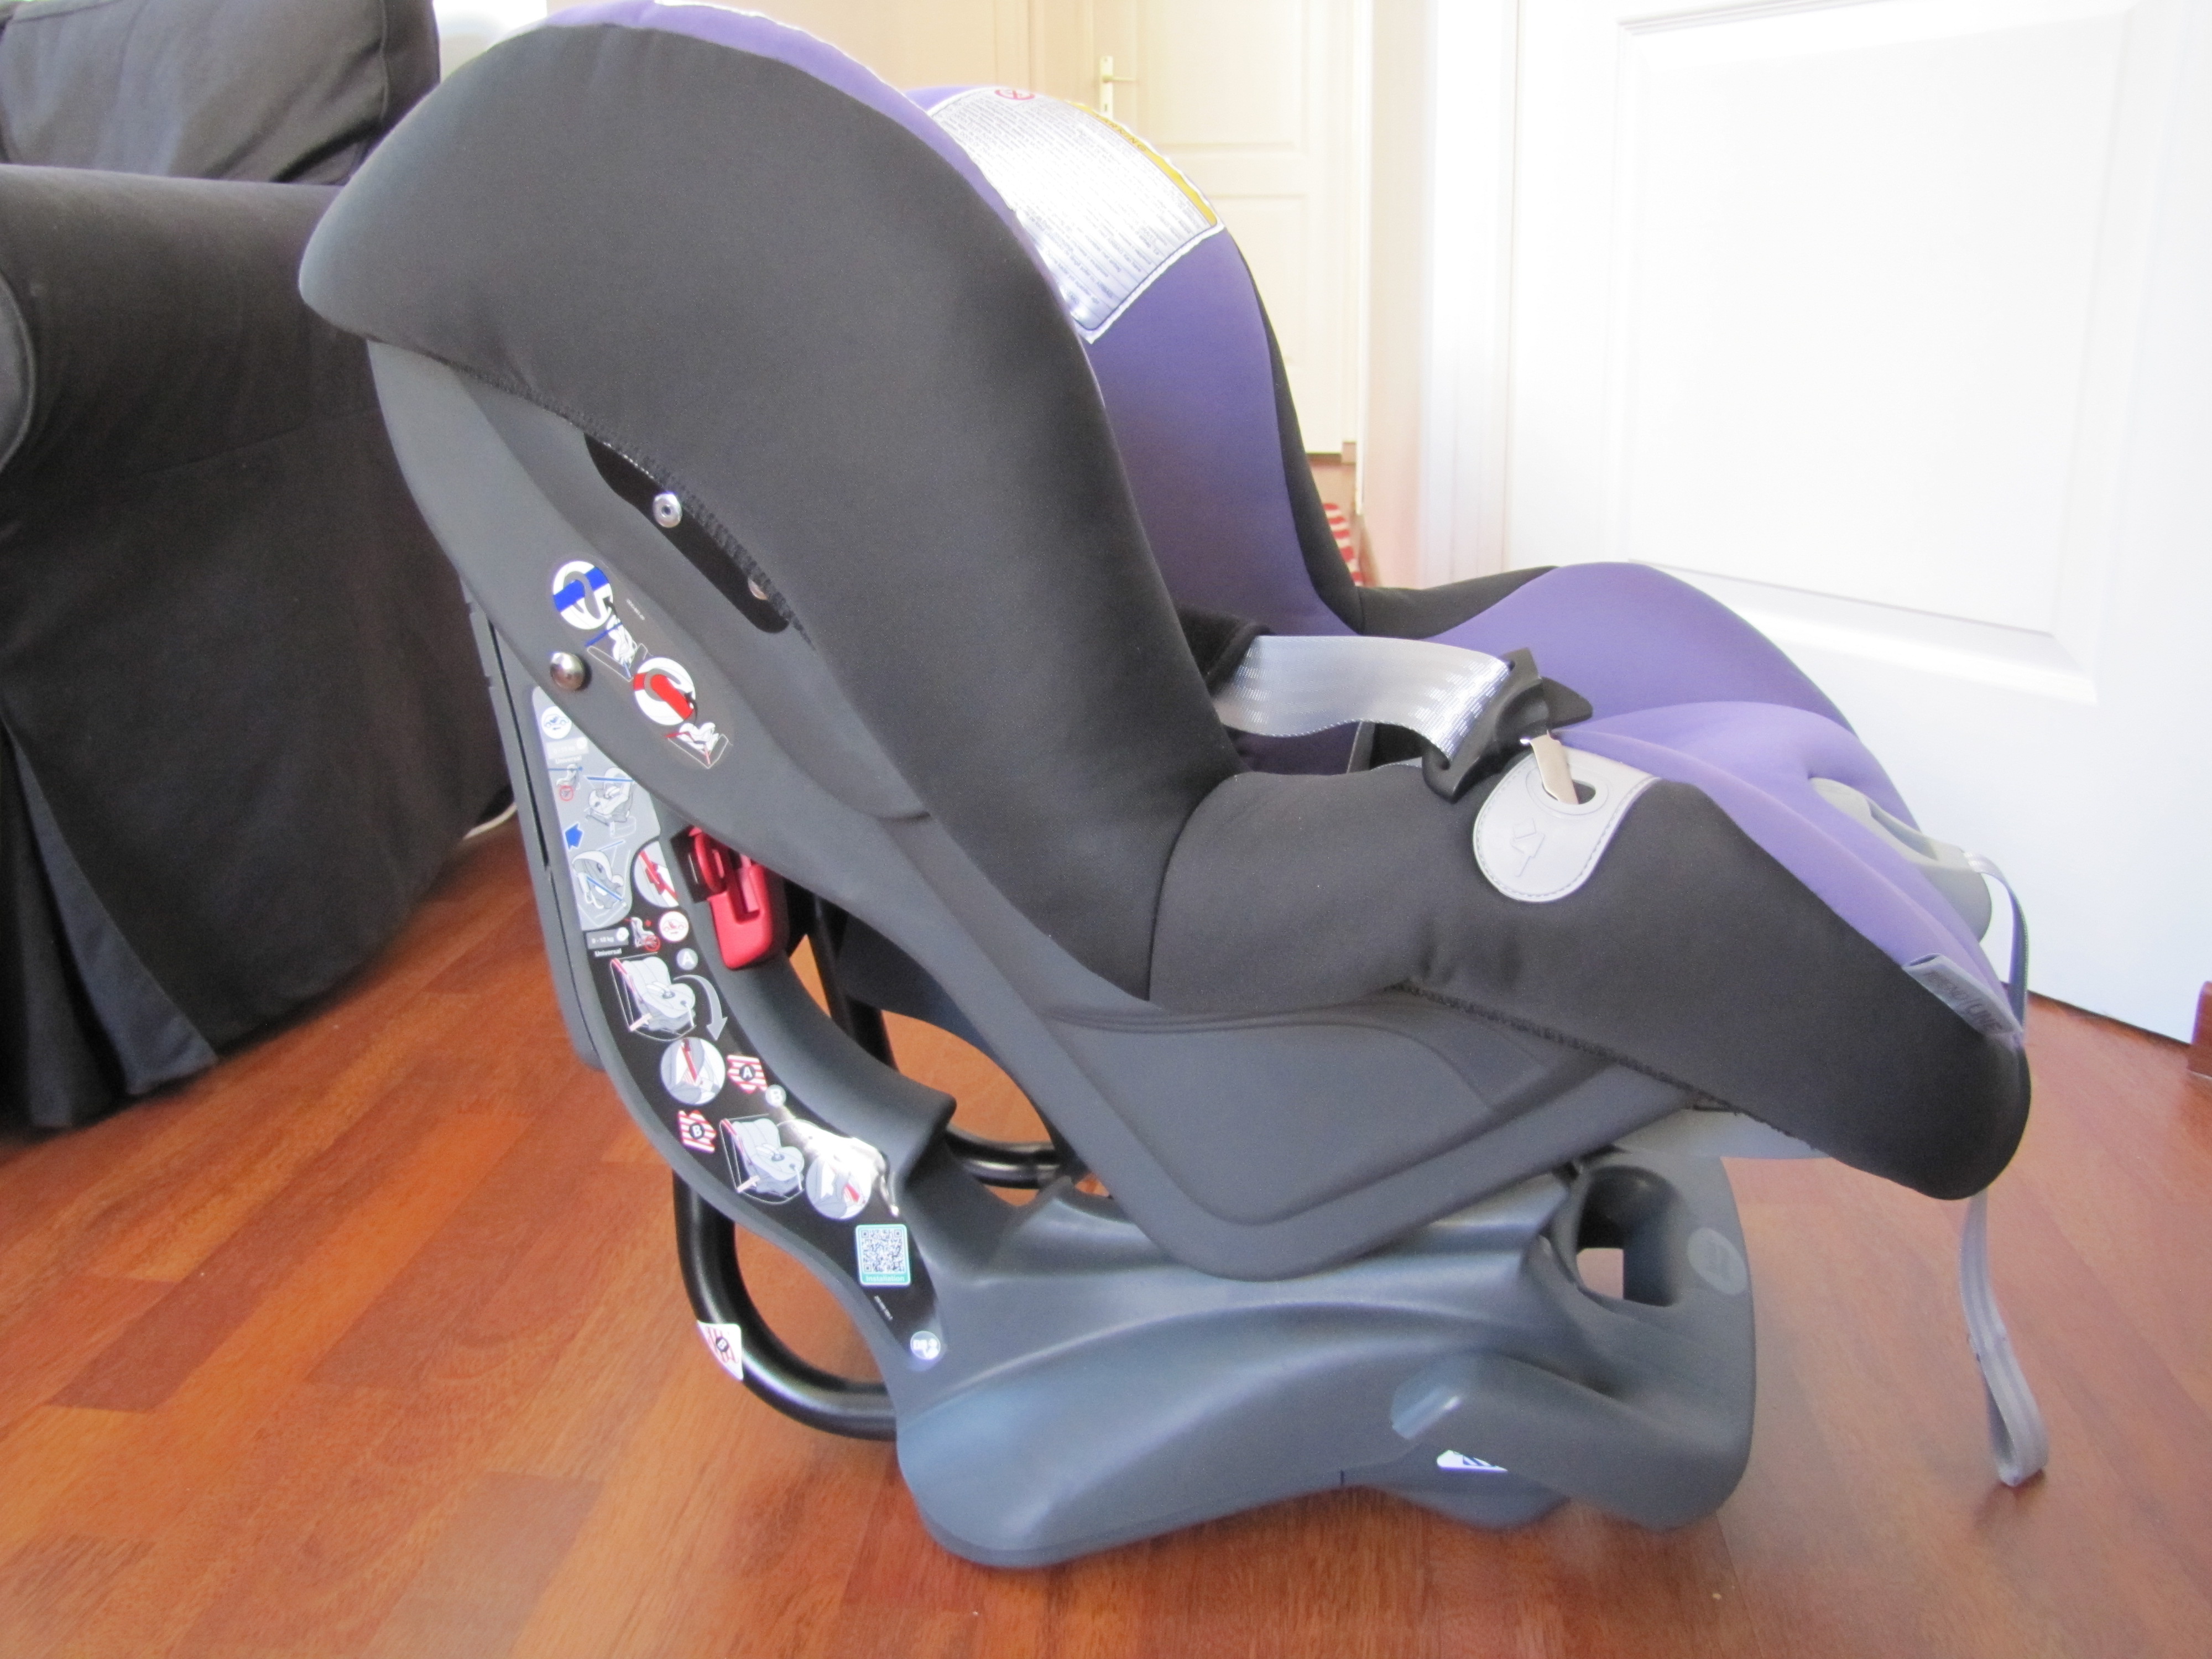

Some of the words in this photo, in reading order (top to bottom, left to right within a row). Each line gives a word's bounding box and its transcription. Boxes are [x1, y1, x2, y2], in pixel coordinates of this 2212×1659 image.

[594, 947, 623, 958] Universal
[682, 951, 695, 965] A
[743, 1066, 753, 1079] A
[770, 1089, 783, 1103] B
[692, 1124, 702, 1137] B
[866, 1275, 905, 1283] Installation
[717, 1339, 728, 1350] B
